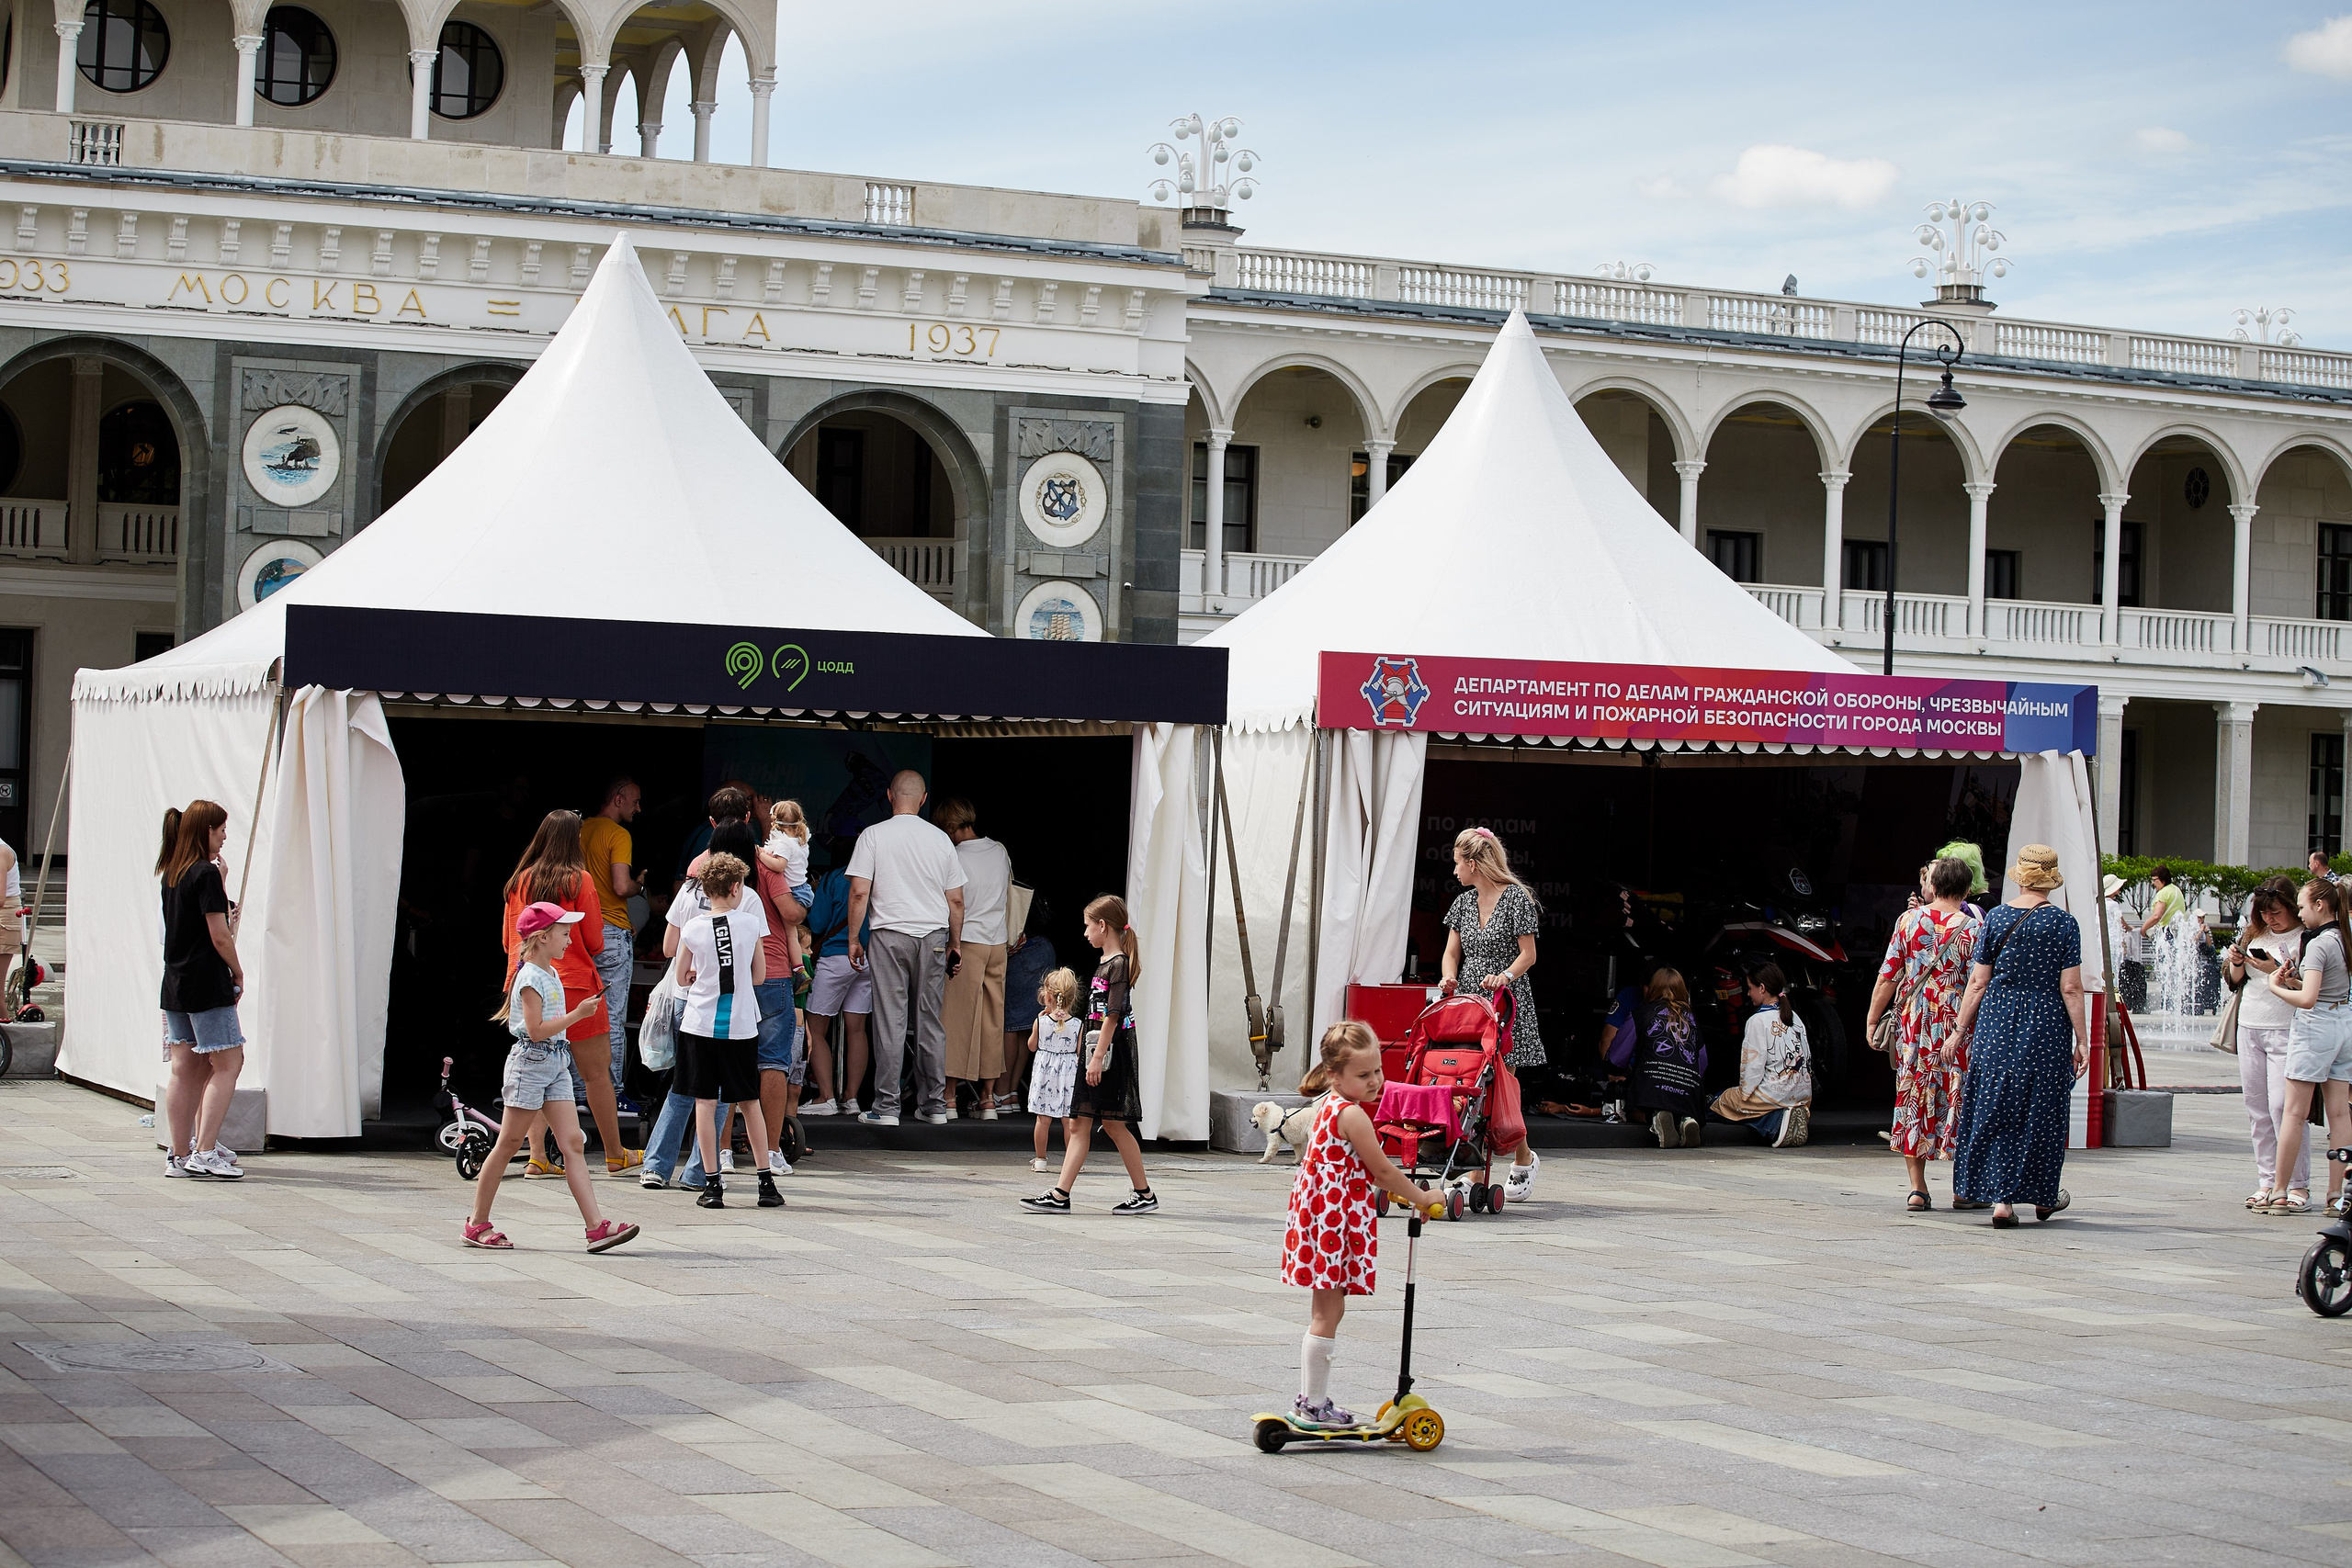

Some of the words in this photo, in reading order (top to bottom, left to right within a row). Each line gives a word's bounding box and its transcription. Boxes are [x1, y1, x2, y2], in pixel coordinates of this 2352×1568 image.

[0, 258, 70, 293] 933
[168, 271, 427, 318] МОСКВА
[910, 322, 1001, 357] 1937
[817, 660, 854, 674] ЦОДД
[1453, 677, 1590, 697] ДЕПАРТАМЕНТ
[1594, 682, 1622, 699] ПО
[1625, 684, 1689, 701] ДЕЛАМ
[1694, 686, 1828, 706] ГРАЖДАНСКОЙ
[1833, 693, 1926, 714] ОБОРОНЫ,
[1929, 697, 2069, 717] ЧРЕЗВЫЧАЙНЫМ
[1453, 700, 1569, 720] СИТУАЦИЯМ
[1575, 705, 1588, 720] И
[1593, 705, 1699, 724] ПОЖАРНОЙ
[1703, 710, 1848, 730] БЕЗОПАСНОСТИ
[1852, 716, 1923, 734] ГОРОДА
[1927, 718, 2002, 737] МОСКВЫ
[1427, 816, 1456, 830] по
